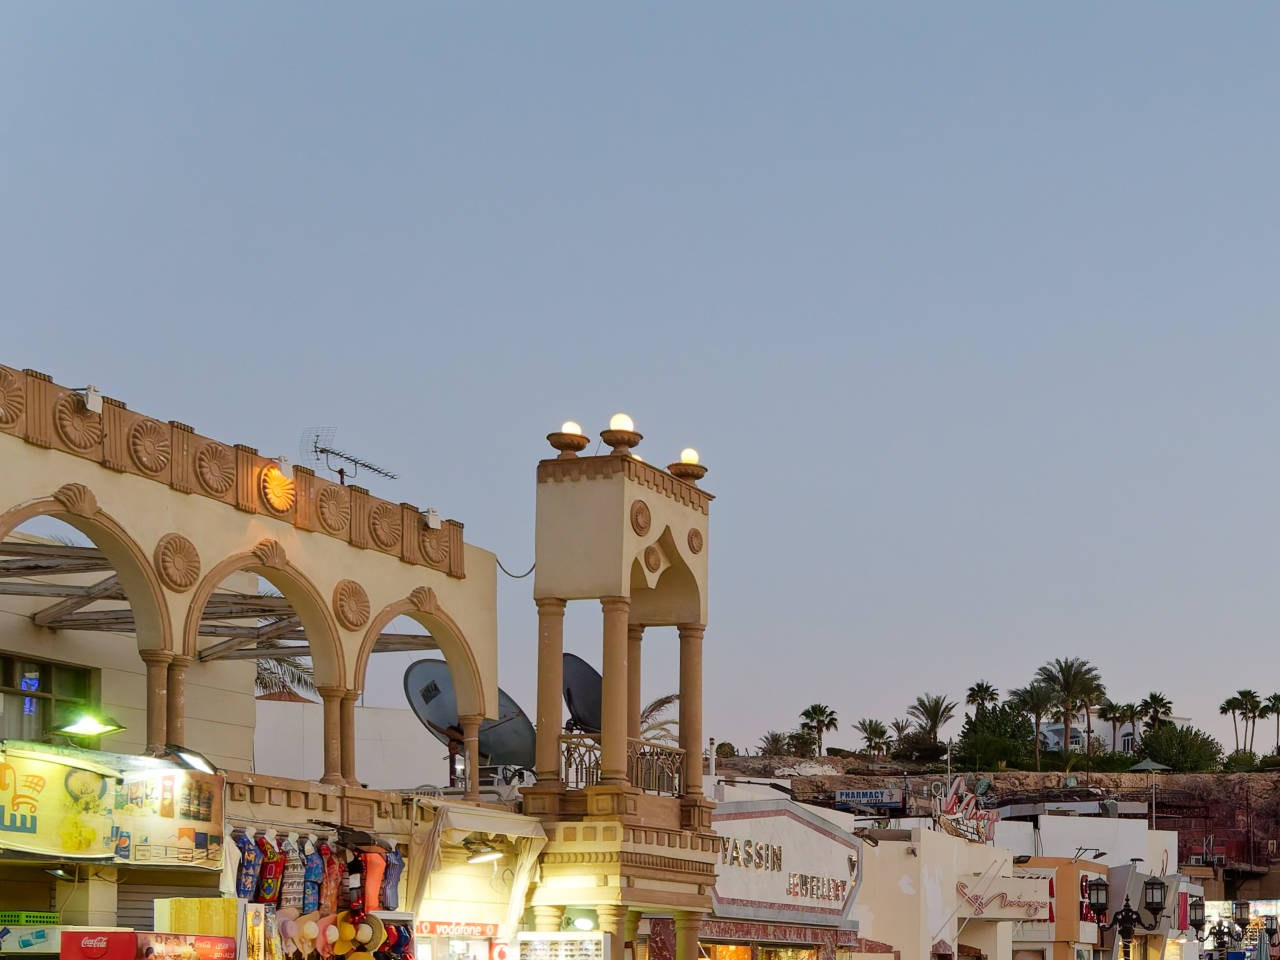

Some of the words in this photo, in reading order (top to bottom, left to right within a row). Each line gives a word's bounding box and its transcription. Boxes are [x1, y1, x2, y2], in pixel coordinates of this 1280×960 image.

[840, 791, 884, 799] PHARMACY
[722, 837, 782, 873] YASSIN
[786, 872, 847, 902] JEWELLERY
[436, 921, 482, 937] vodafone
